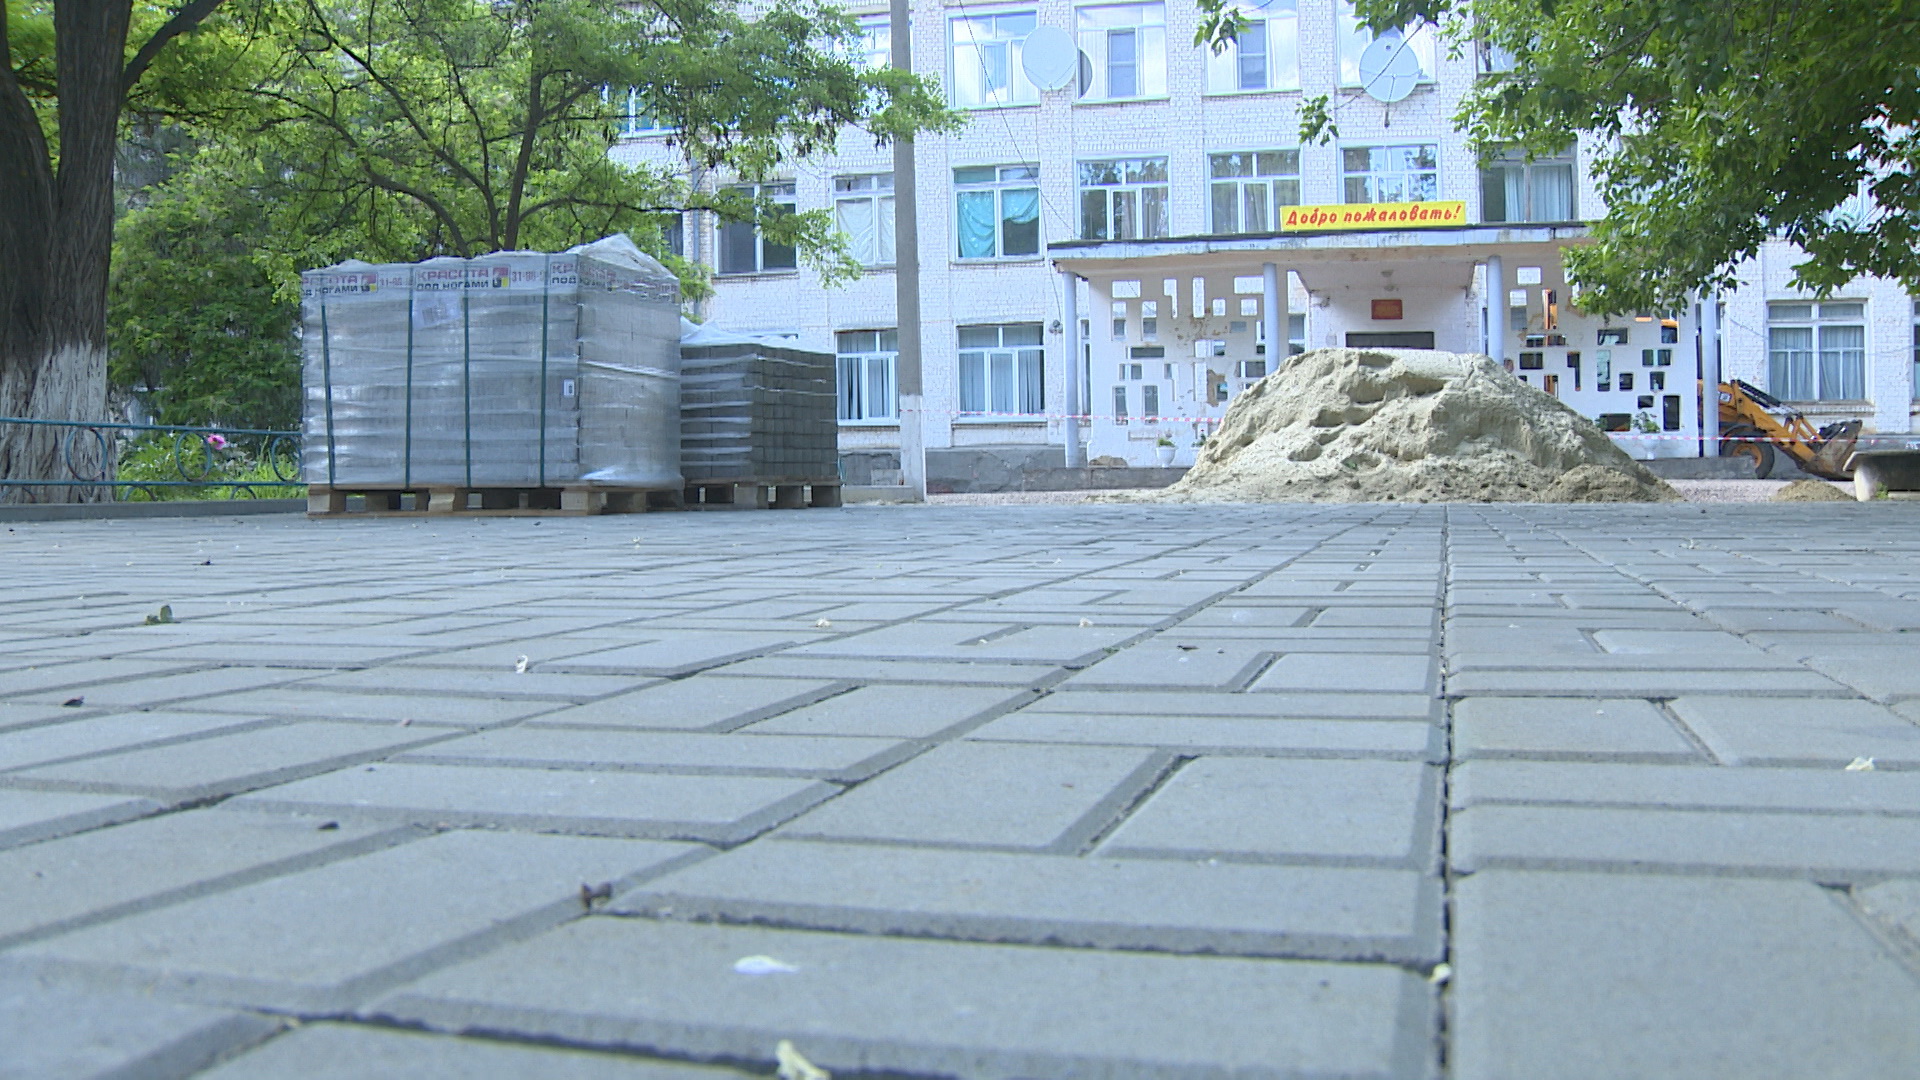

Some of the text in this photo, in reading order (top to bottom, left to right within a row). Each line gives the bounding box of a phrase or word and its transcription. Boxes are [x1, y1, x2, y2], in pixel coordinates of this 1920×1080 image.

[1286, 204, 1462, 227] Добро пожаловать!
[416, 267, 489, 281] КРАСОТА
[442, 280, 489, 290] НОГАМИ
